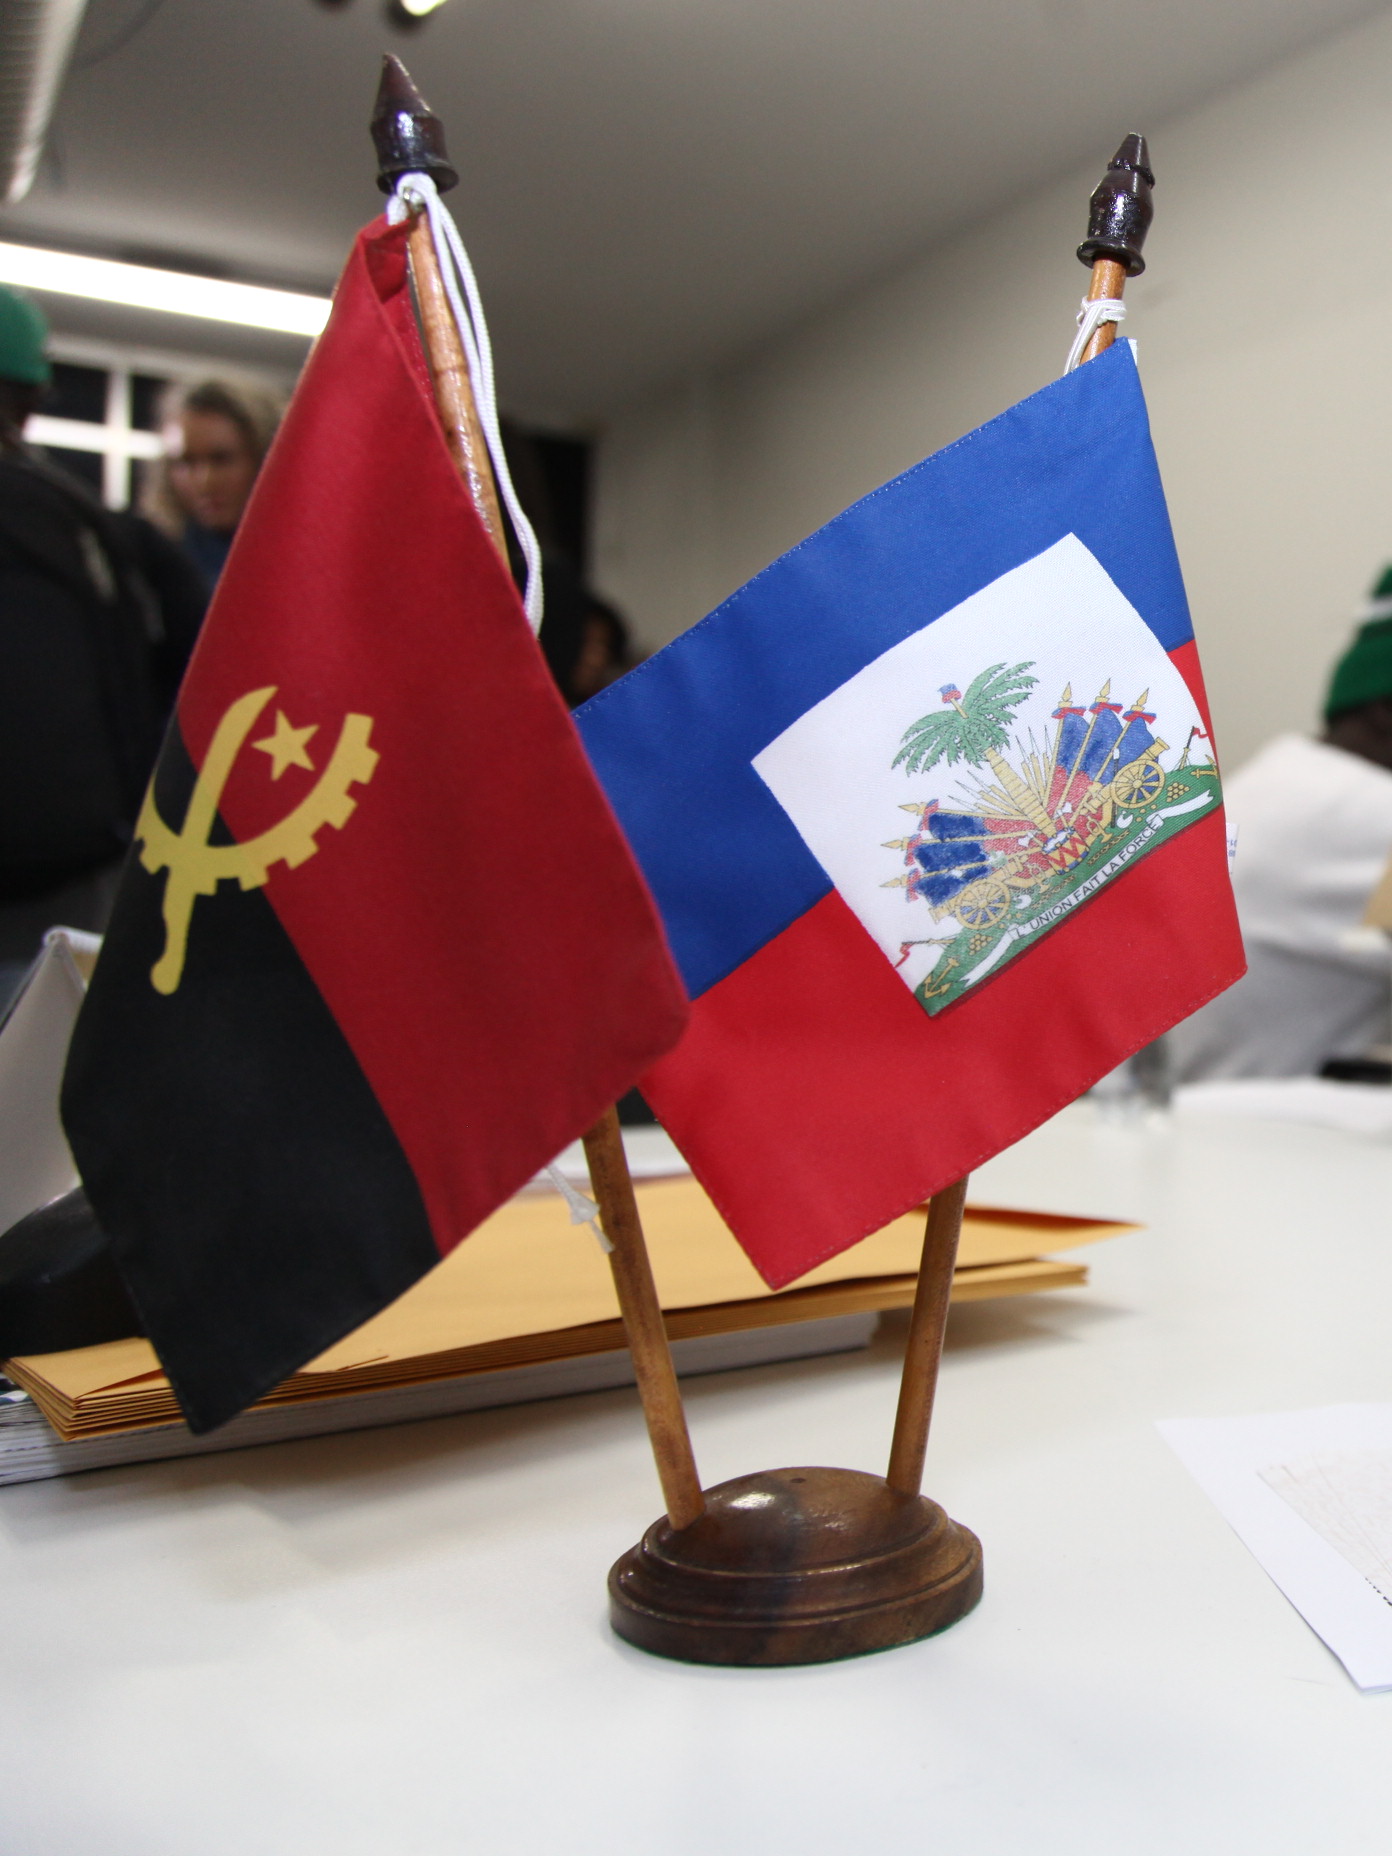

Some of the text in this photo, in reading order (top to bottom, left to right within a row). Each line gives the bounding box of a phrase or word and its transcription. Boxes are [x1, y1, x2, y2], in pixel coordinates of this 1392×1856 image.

[1074, 873, 1101, 901] FAIT
[1103, 861, 1121, 878] LA
[1118, 823, 1159, 863] FORCE
